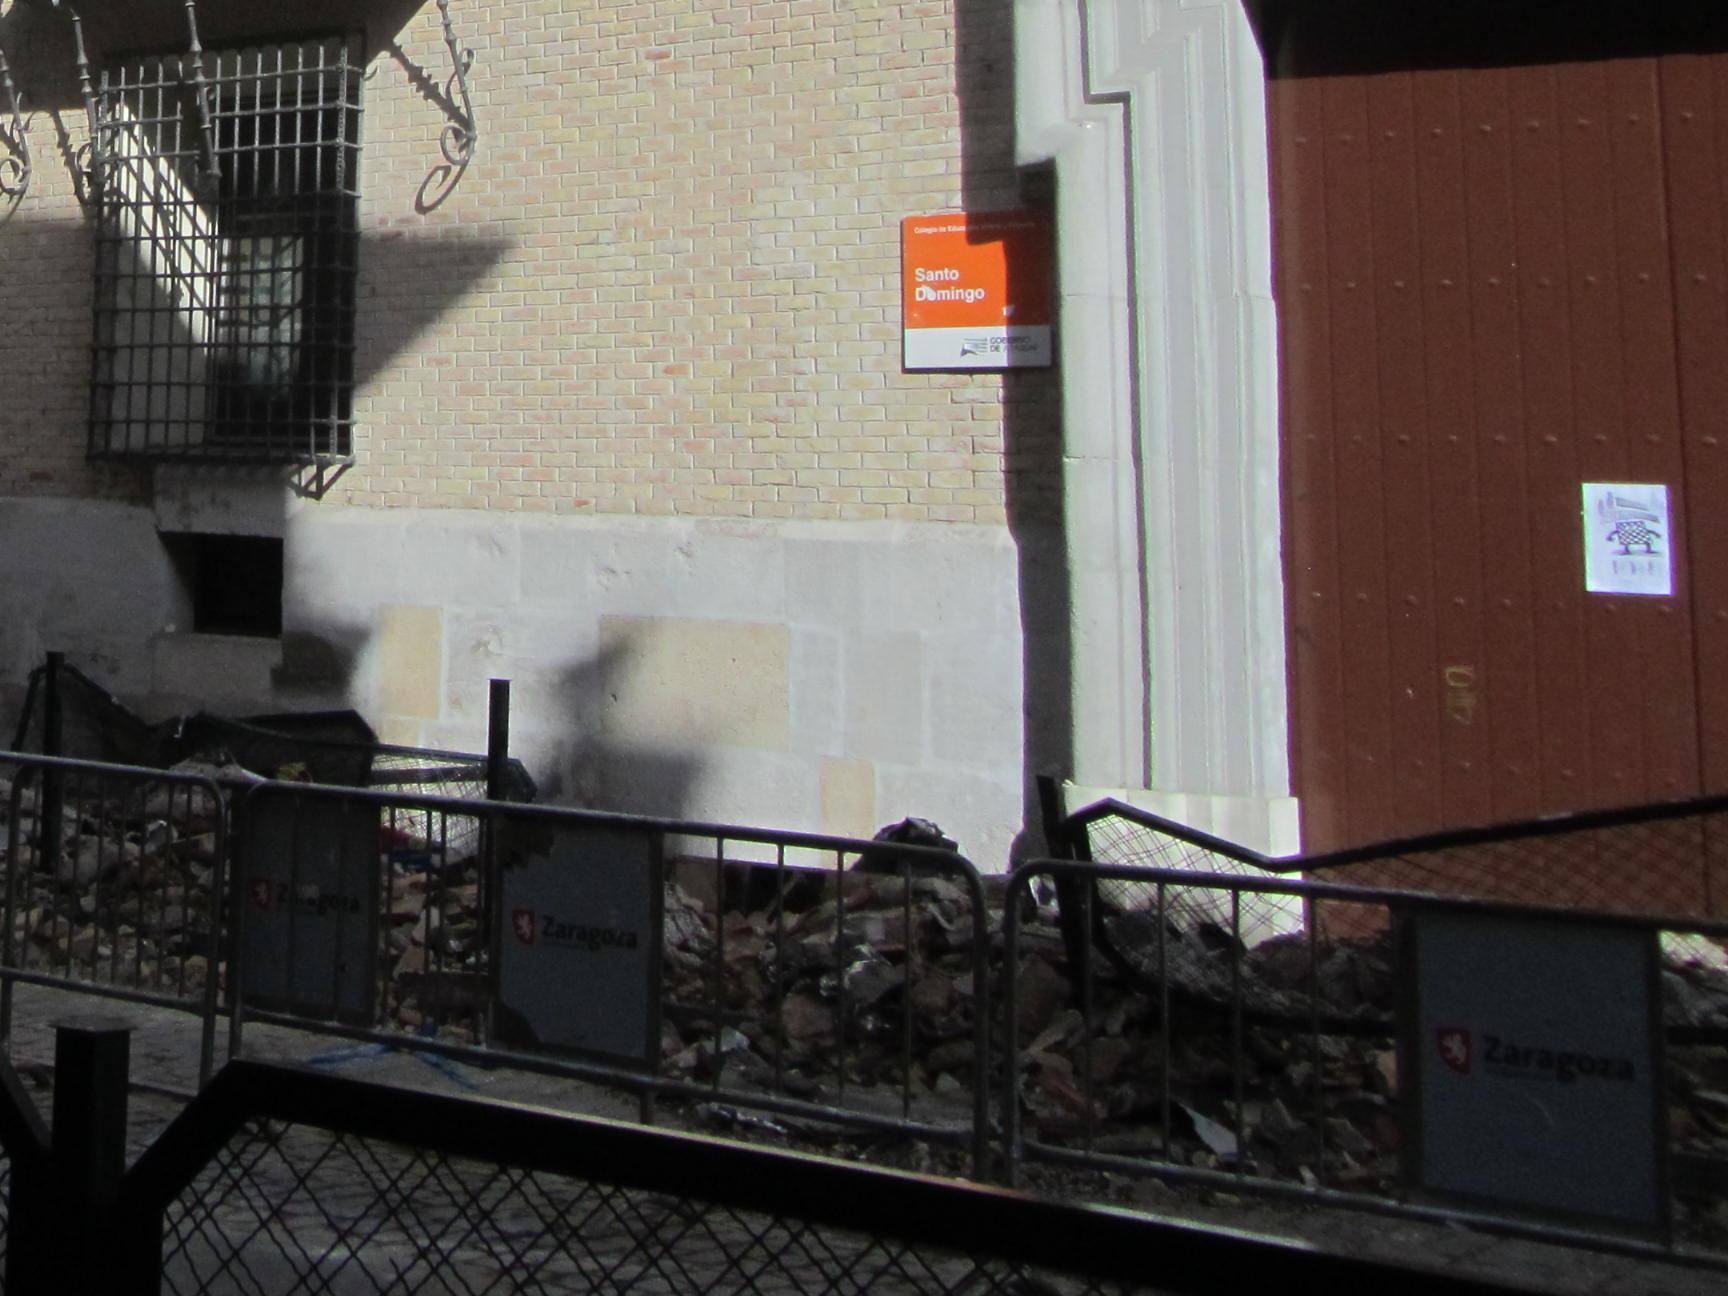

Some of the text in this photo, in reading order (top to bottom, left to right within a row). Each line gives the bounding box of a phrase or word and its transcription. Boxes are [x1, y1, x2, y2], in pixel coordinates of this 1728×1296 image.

[915, 267, 960, 282] Santo
[915, 286, 985, 303] Domingo
[542, 915, 638, 952] Zaragoza
[1483, 1034, 1634, 1083] Zaragoza
